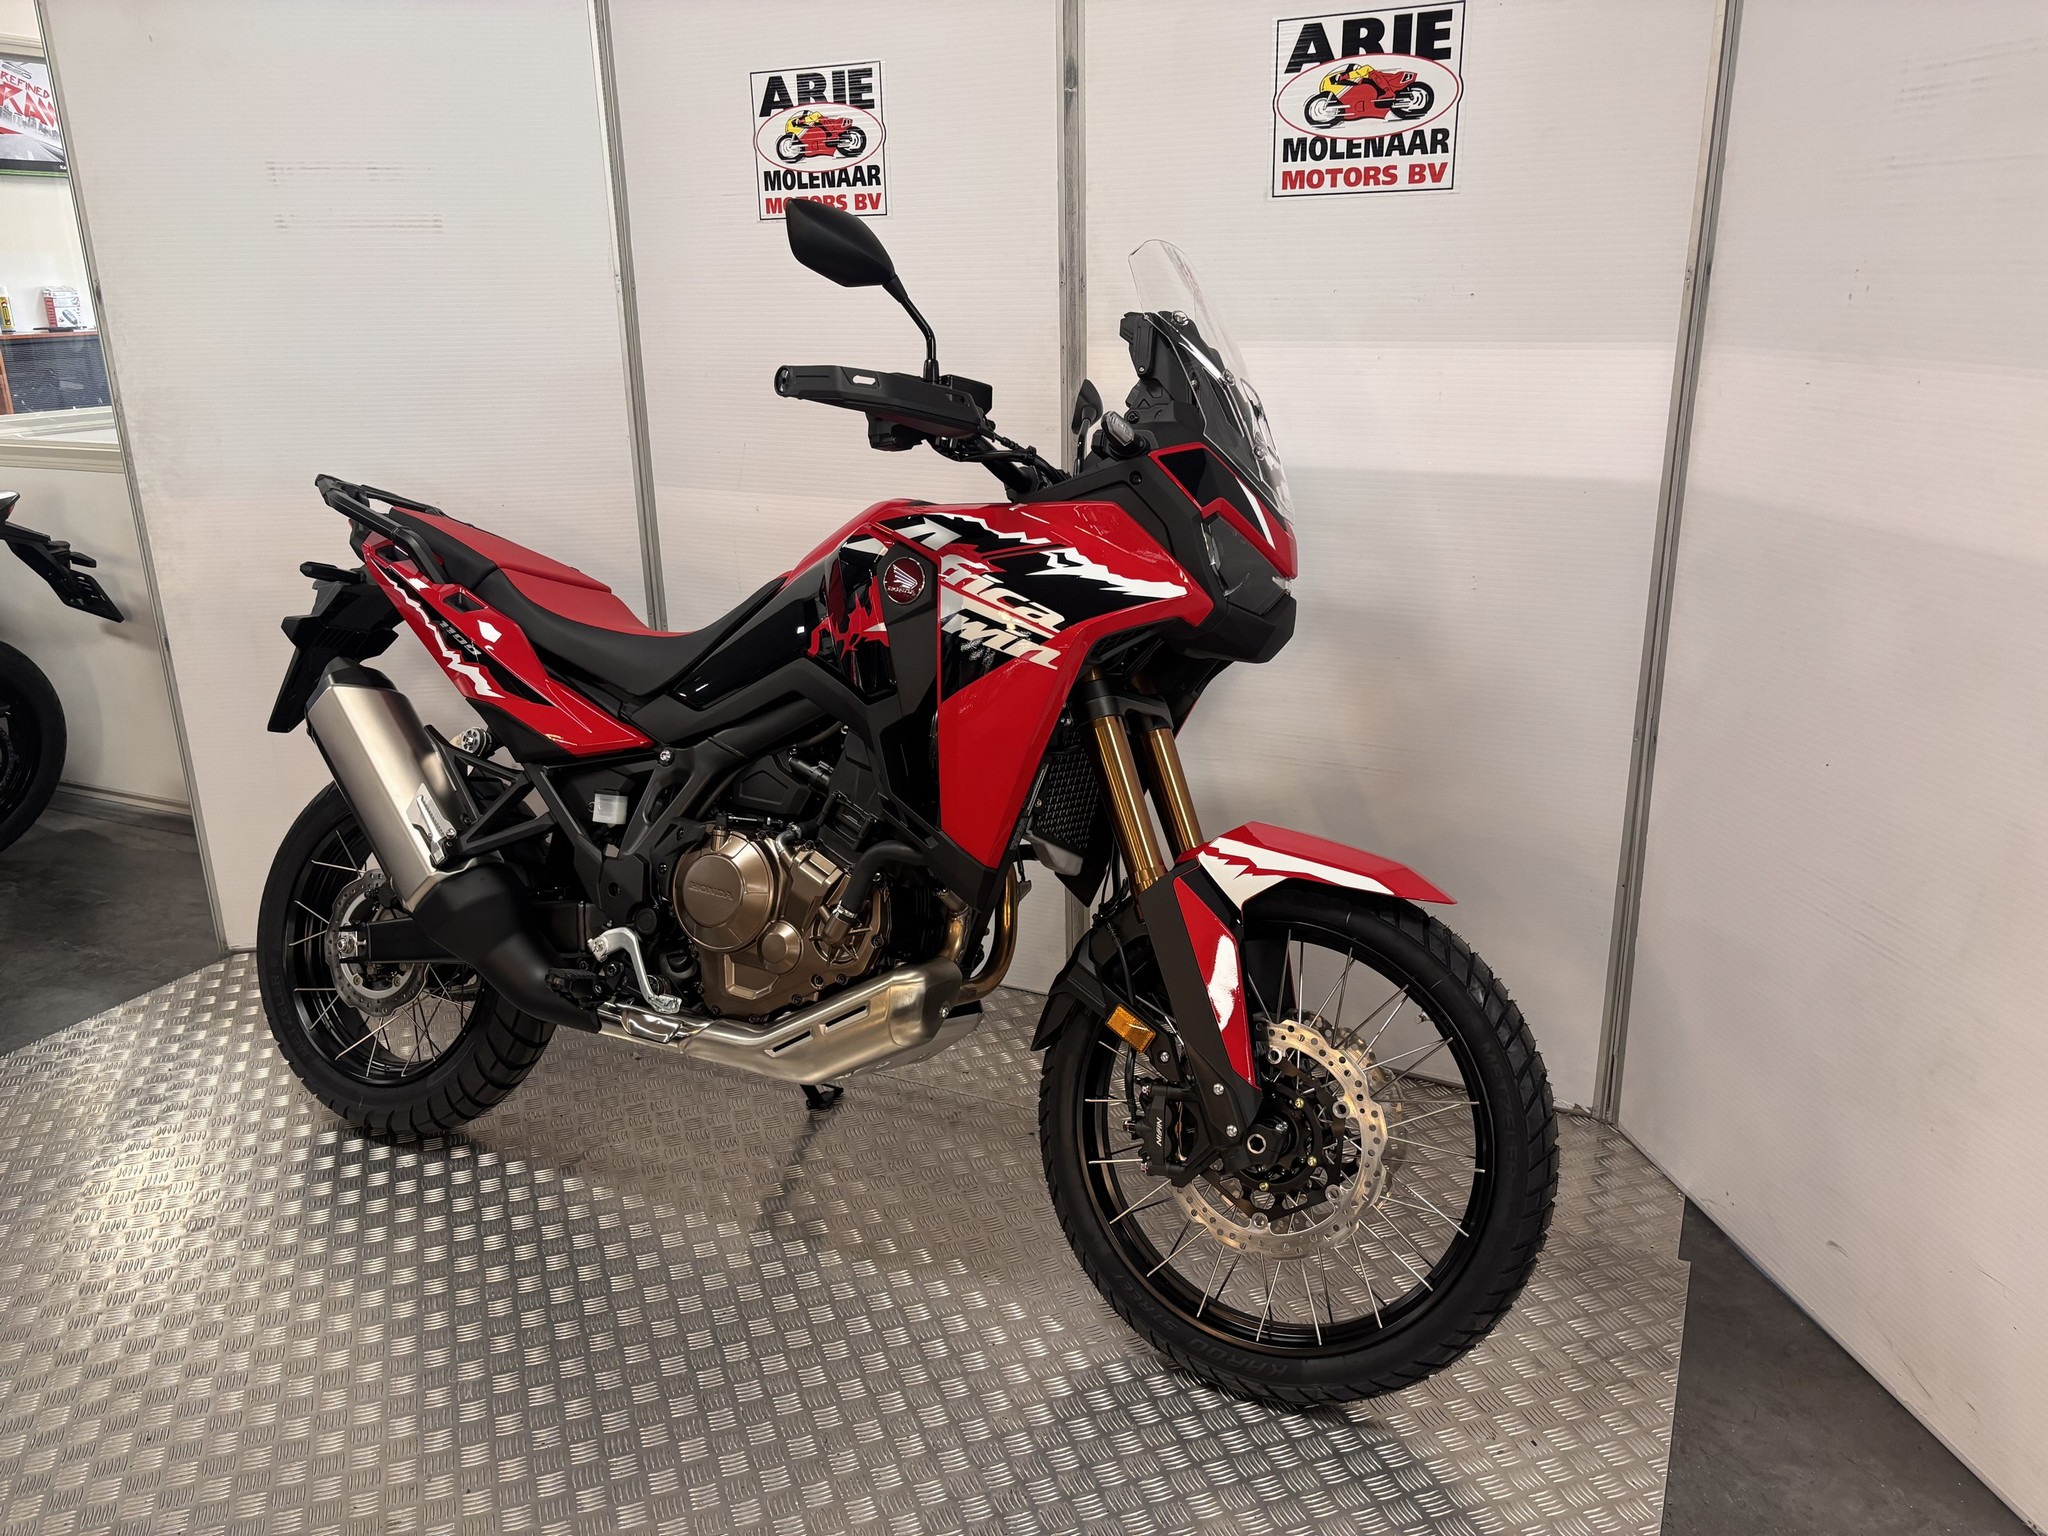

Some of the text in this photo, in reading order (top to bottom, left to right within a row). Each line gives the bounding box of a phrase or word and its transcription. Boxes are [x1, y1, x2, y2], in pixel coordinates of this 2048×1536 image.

[1284, 9, 1453, 74] ARIE
[0, 70, 51, 99] REFINED
[758, 67, 875, 117] ARIE
[1282, 127, 1451, 163] MOLENAAR
[763, 165, 881, 191] MOLENAAR
[1281, 162, 1448, 190] MOTORS BV
[854, 193, 882, 210] BV
[688, 880, 734, 901] HONDA
